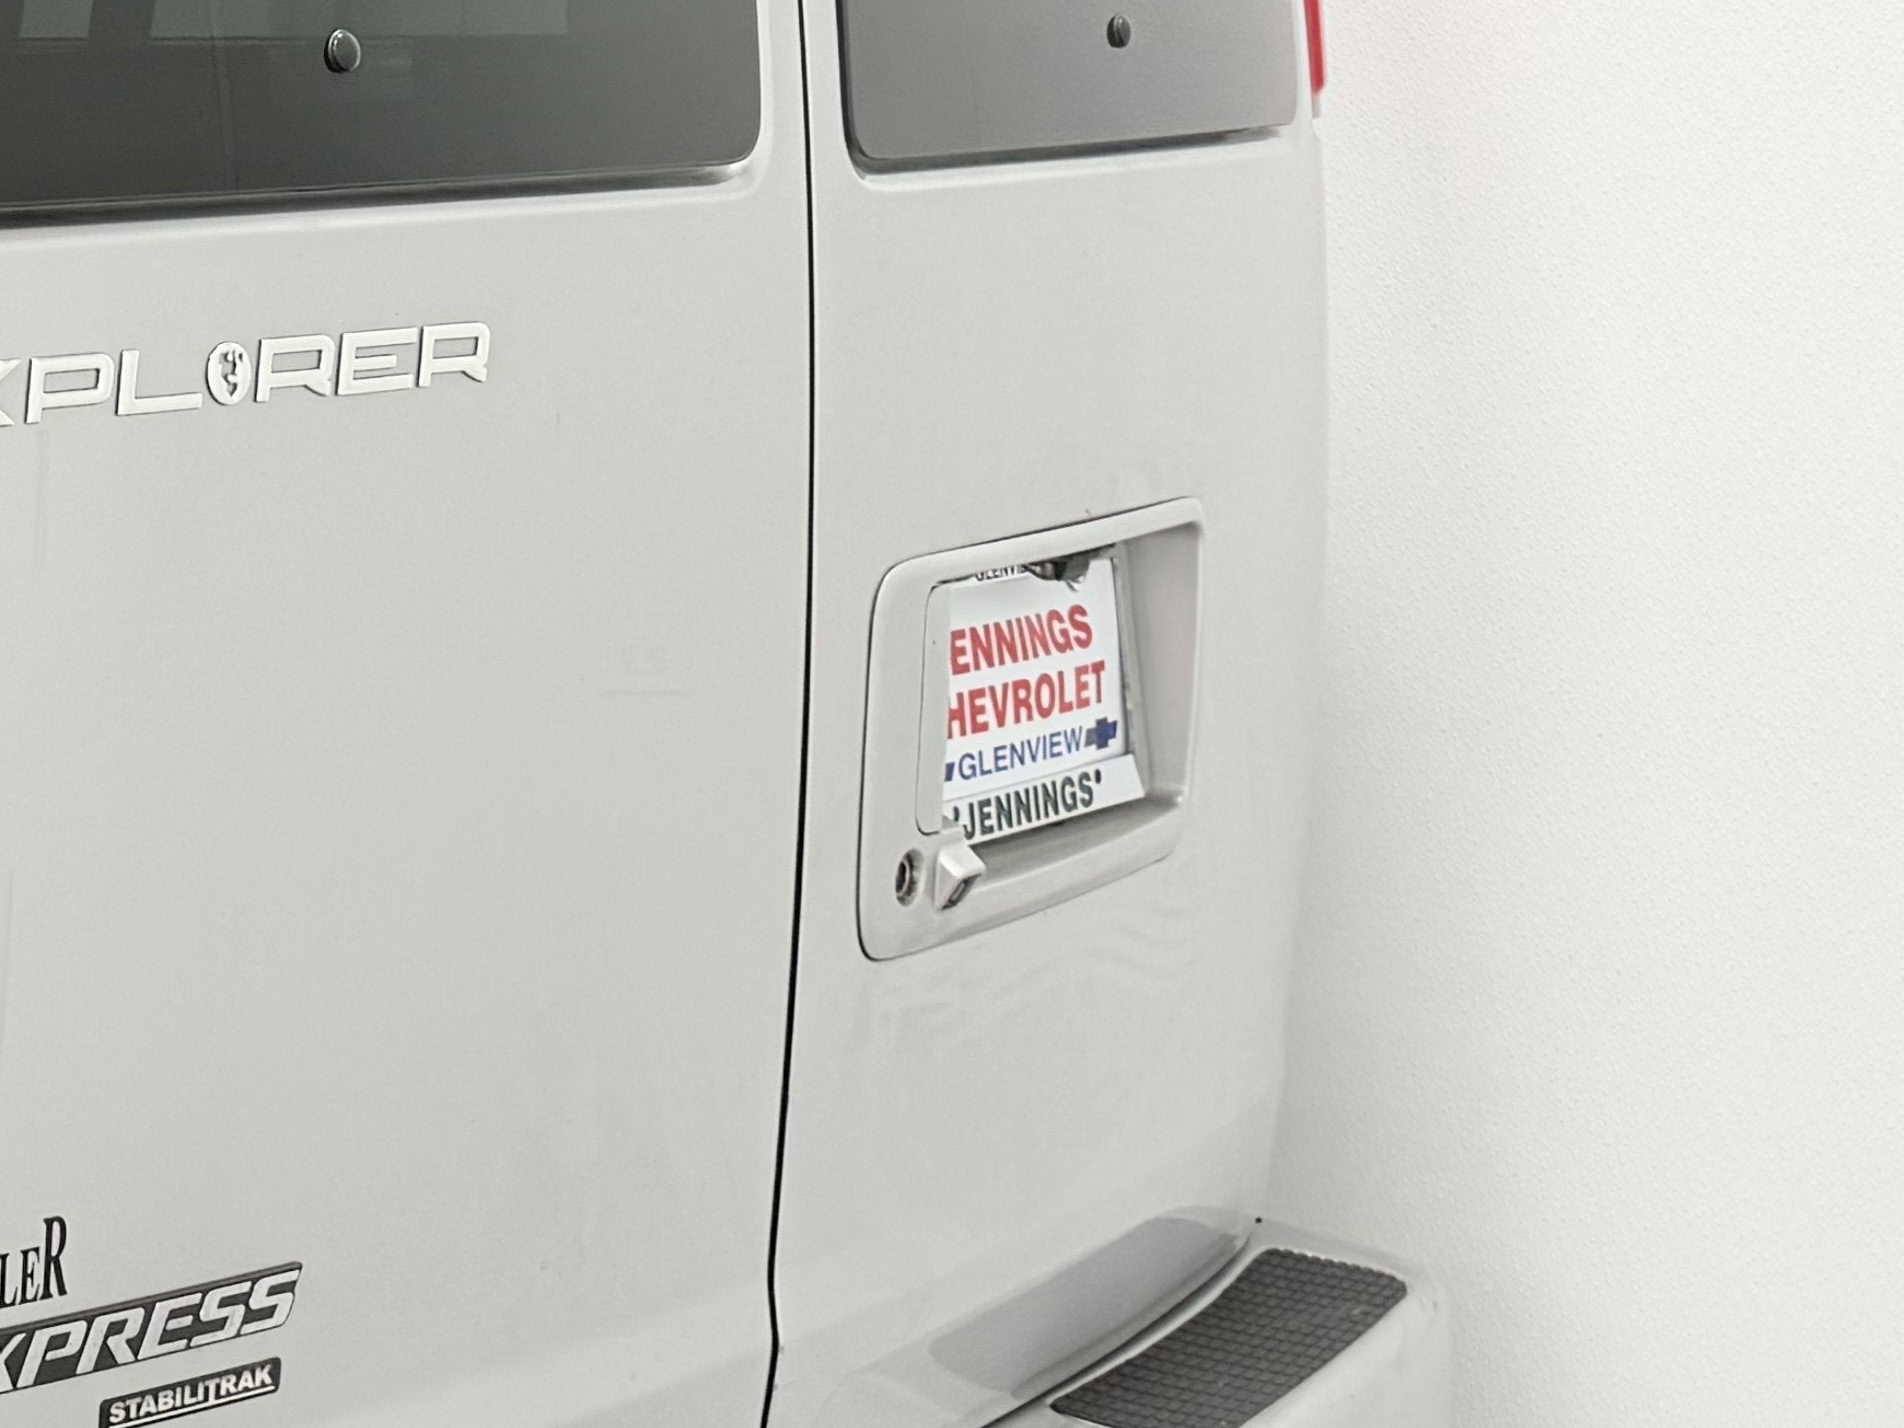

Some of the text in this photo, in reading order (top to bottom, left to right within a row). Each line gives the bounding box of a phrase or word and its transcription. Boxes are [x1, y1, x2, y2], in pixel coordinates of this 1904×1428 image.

[949, 603, 1093, 676] ENNINGS
[946, 659, 1106, 739] HEVROLET
[958, 726, 1085, 781] GLENVIEW
[108, 1363, 274, 1424] STABILITRAK
